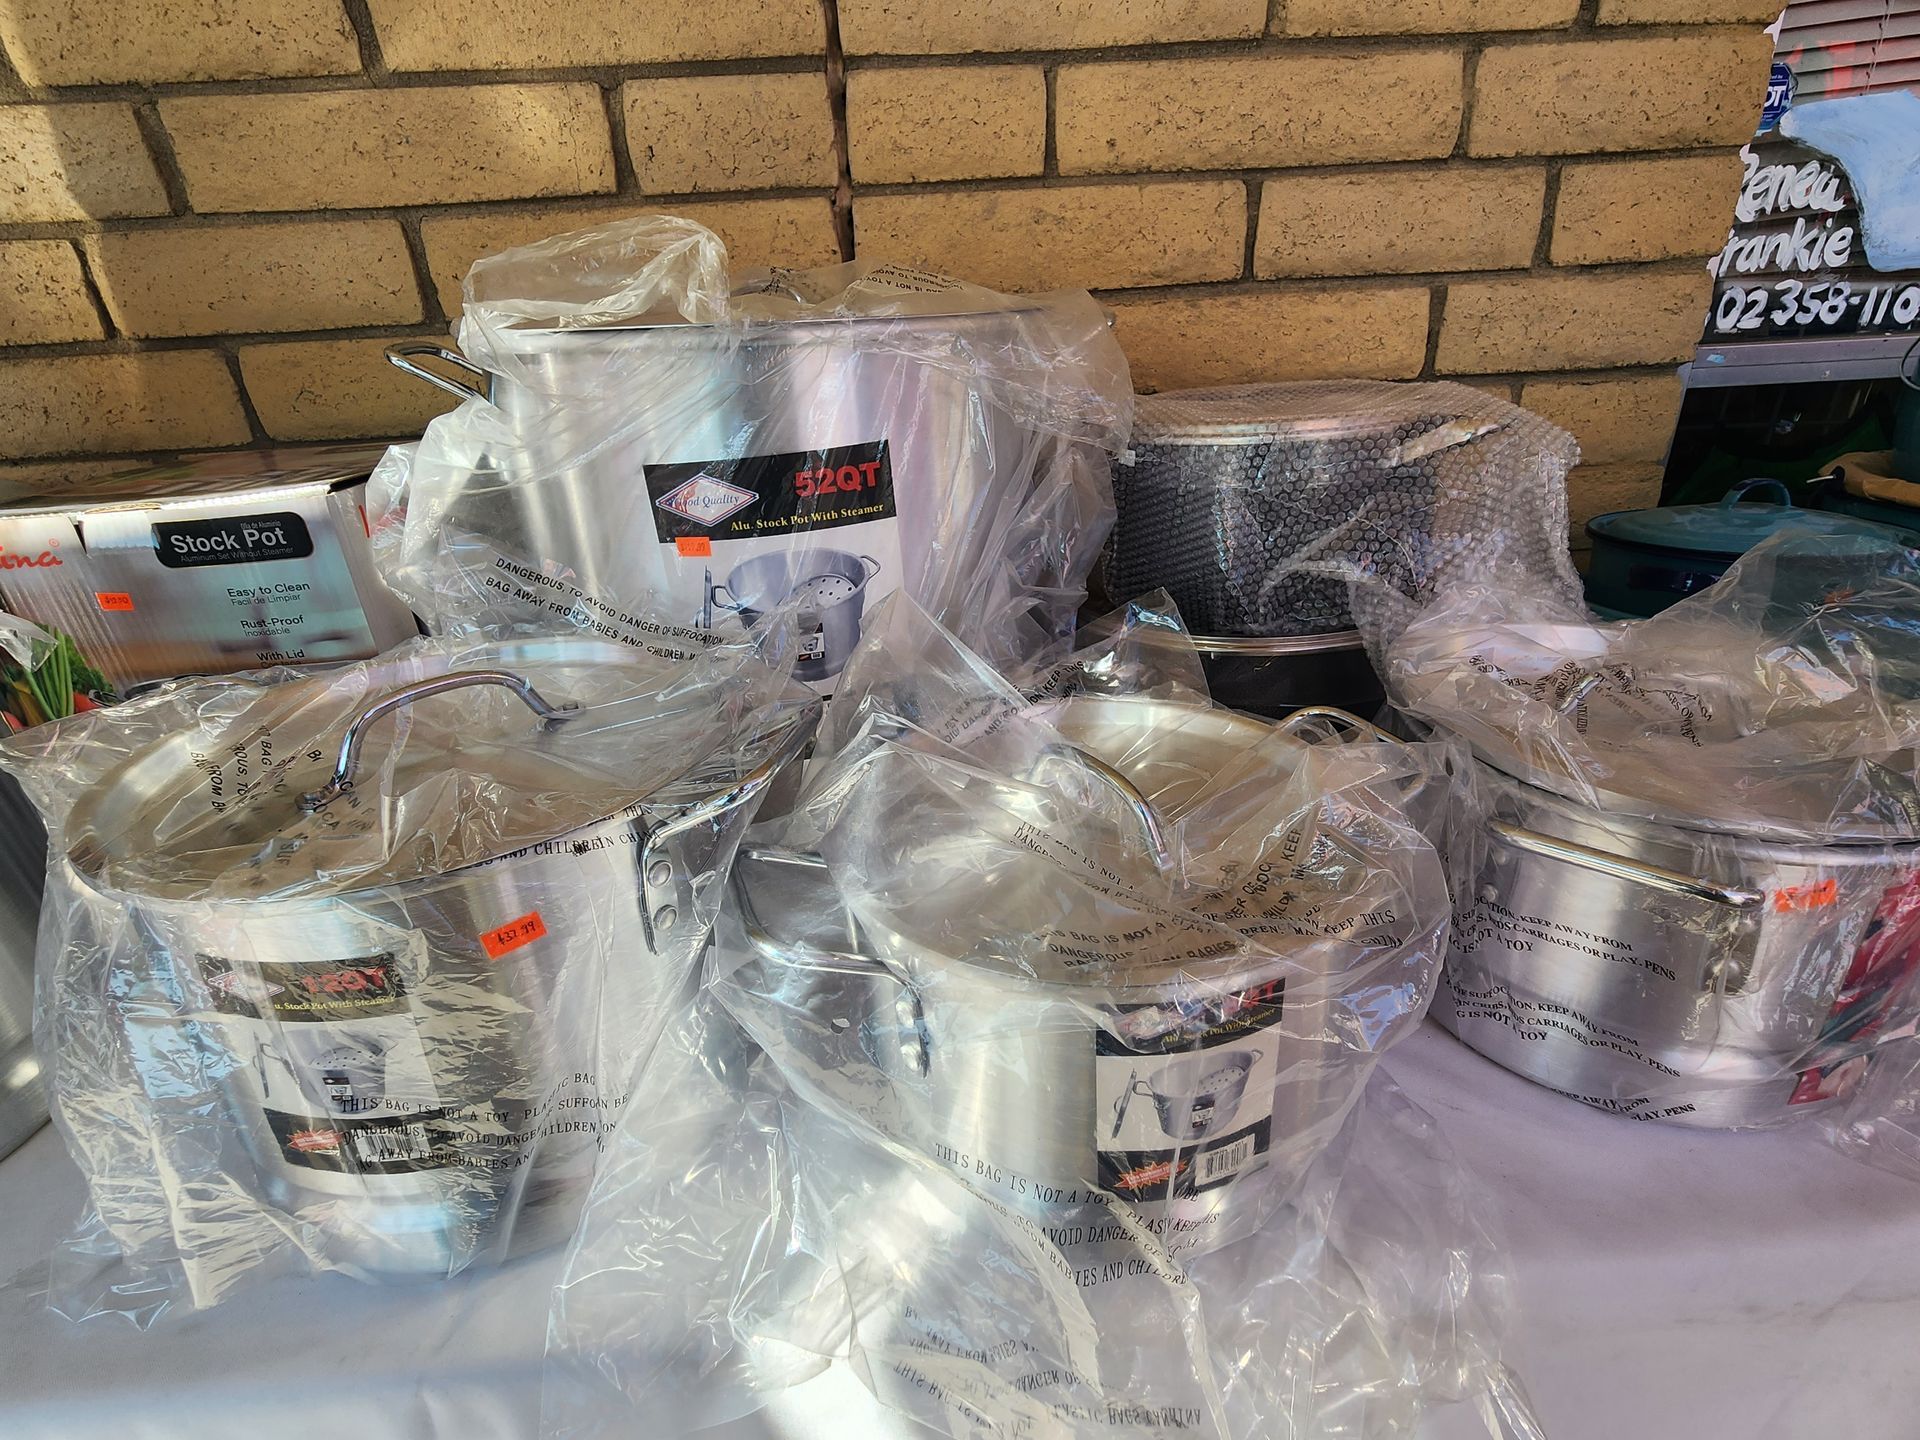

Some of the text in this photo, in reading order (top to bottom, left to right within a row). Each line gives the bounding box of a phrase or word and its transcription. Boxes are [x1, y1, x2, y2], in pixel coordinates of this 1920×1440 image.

[1718, 216, 1853, 278] rankie
[795, 462, 881, 498] 52QT
[702, 494, 740, 508] Quality
[730, 502, 884, 532] Alu. Stock Pot With Steamer
[170, 527, 288, 553] Stock Pot
[263, 546, 294, 556] Steamer
[227, 583, 310, 598] Easy to Clean
[267, 594, 301, 604] Limpiar
[496, 558, 565, 593] DANGEROUS,
[569, 587, 583, 598] TO
[585, 596, 616, 618] AVOID
[619, 613, 660, 636] DANGER
[662, 626, 671, 636] OF
[240, 614, 304, 629] Rust-Proof
[486, 576, 511, 593] BAG
[513, 588, 546, 607] AWAY
[548, 602, 579, 620] FROM
[582, 616, 619, 640] BABIES
[620, 635, 644, 648] AND
[244, 628, 290, 637] Inoxidable
[256, 649, 305, 661] With Lid
[1042, 660, 1084, 693] KEEP THIS
[260, 740, 273, 767] BAG
[1360, 909, 1396, 926] THIS
[1122, 926, 1152, 942] NOT
[1504, 938, 1534, 952] TOY
[1554, 922, 1591, 940] AWAY
[1594, 934, 1634, 952] FROM
[1514, 922, 1677, 982] CARRIAGES OR PLAY. PENS
[285, 1002, 311, 1010] Stock
[328, 1000, 354, 1008] With
[1538, 1002, 1570, 1016] KEEP
[1571, 1011, 1599, 1034] AWAY
[1483, 1011, 1510, 1026] NOT
[1518, 1030, 1548, 1041] TOY
[1527, 1018, 1588, 1046] CARRIAGES
[1590, 1040, 1610, 1048] OR
[1610, 1042, 1647, 1063] PLAY.
[1648, 1057, 1682, 1078] PENS
[340, 1098, 378, 1112] THIS
[386, 1100, 410, 1112] BAG
[418, 1104, 432, 1114] IS
[470, 1112, 478, 1121] A
[484, 1112, 510, 1122] TOY
[1666, 1103, 1697, 1117] PENS
[449, 1131, 490, 1144] AVOID
[357, 1154, 373, 1174] AG
[378, 1148, 413, 1162] AWAY
[458, 1155, 509, 1170] BABIES
[936, 1143, 1114, 1206] THIS BAG IS NOT A TOY
[1088, 1226, 1138, 1242] DANGER
[1144, 1243, 1163, 1257] OF
[1050, 1251, 1124, 1287] BABIES AND
